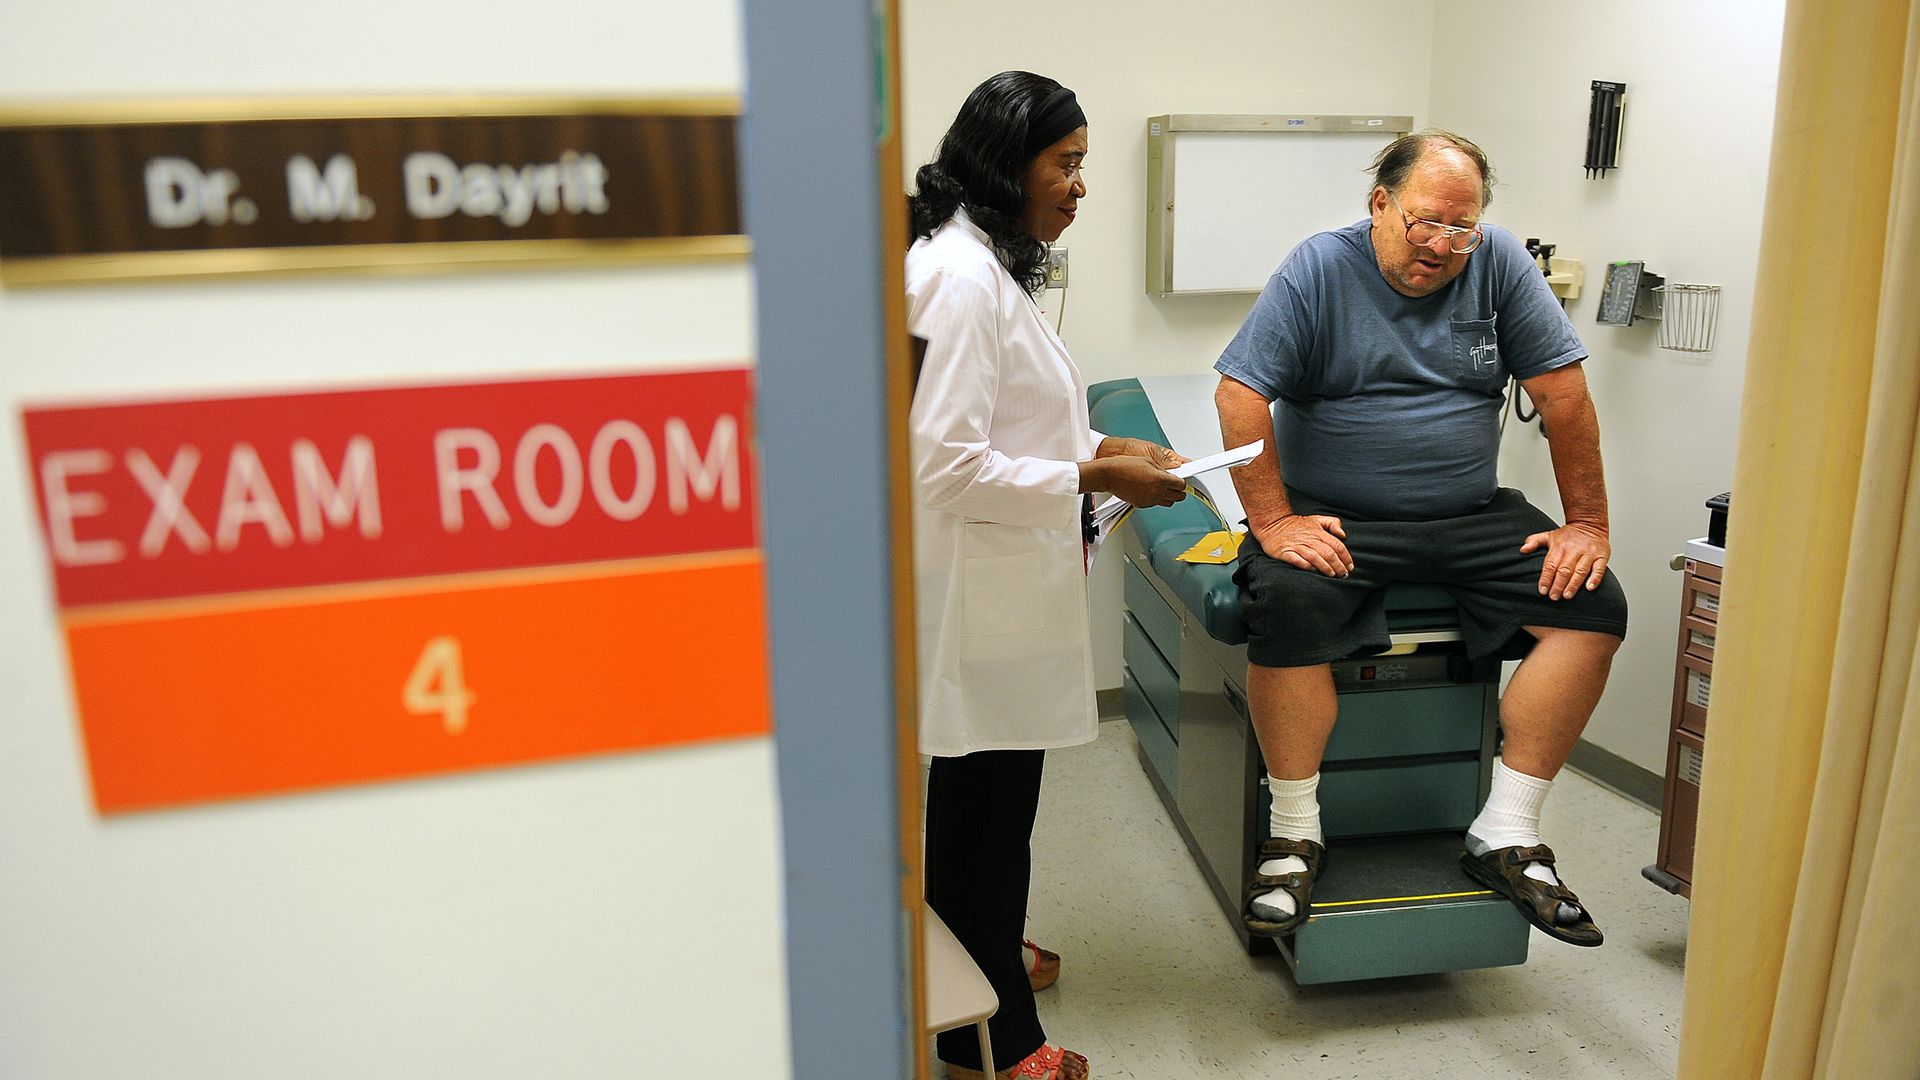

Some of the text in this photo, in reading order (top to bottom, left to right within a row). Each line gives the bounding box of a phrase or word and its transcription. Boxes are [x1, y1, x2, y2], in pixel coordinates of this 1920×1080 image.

[145, 151, 608, 227] Dr. M. Dayrit
[40, 414, 741, 566] EXAM ROOM
[402, 636, 475, 734] 4
